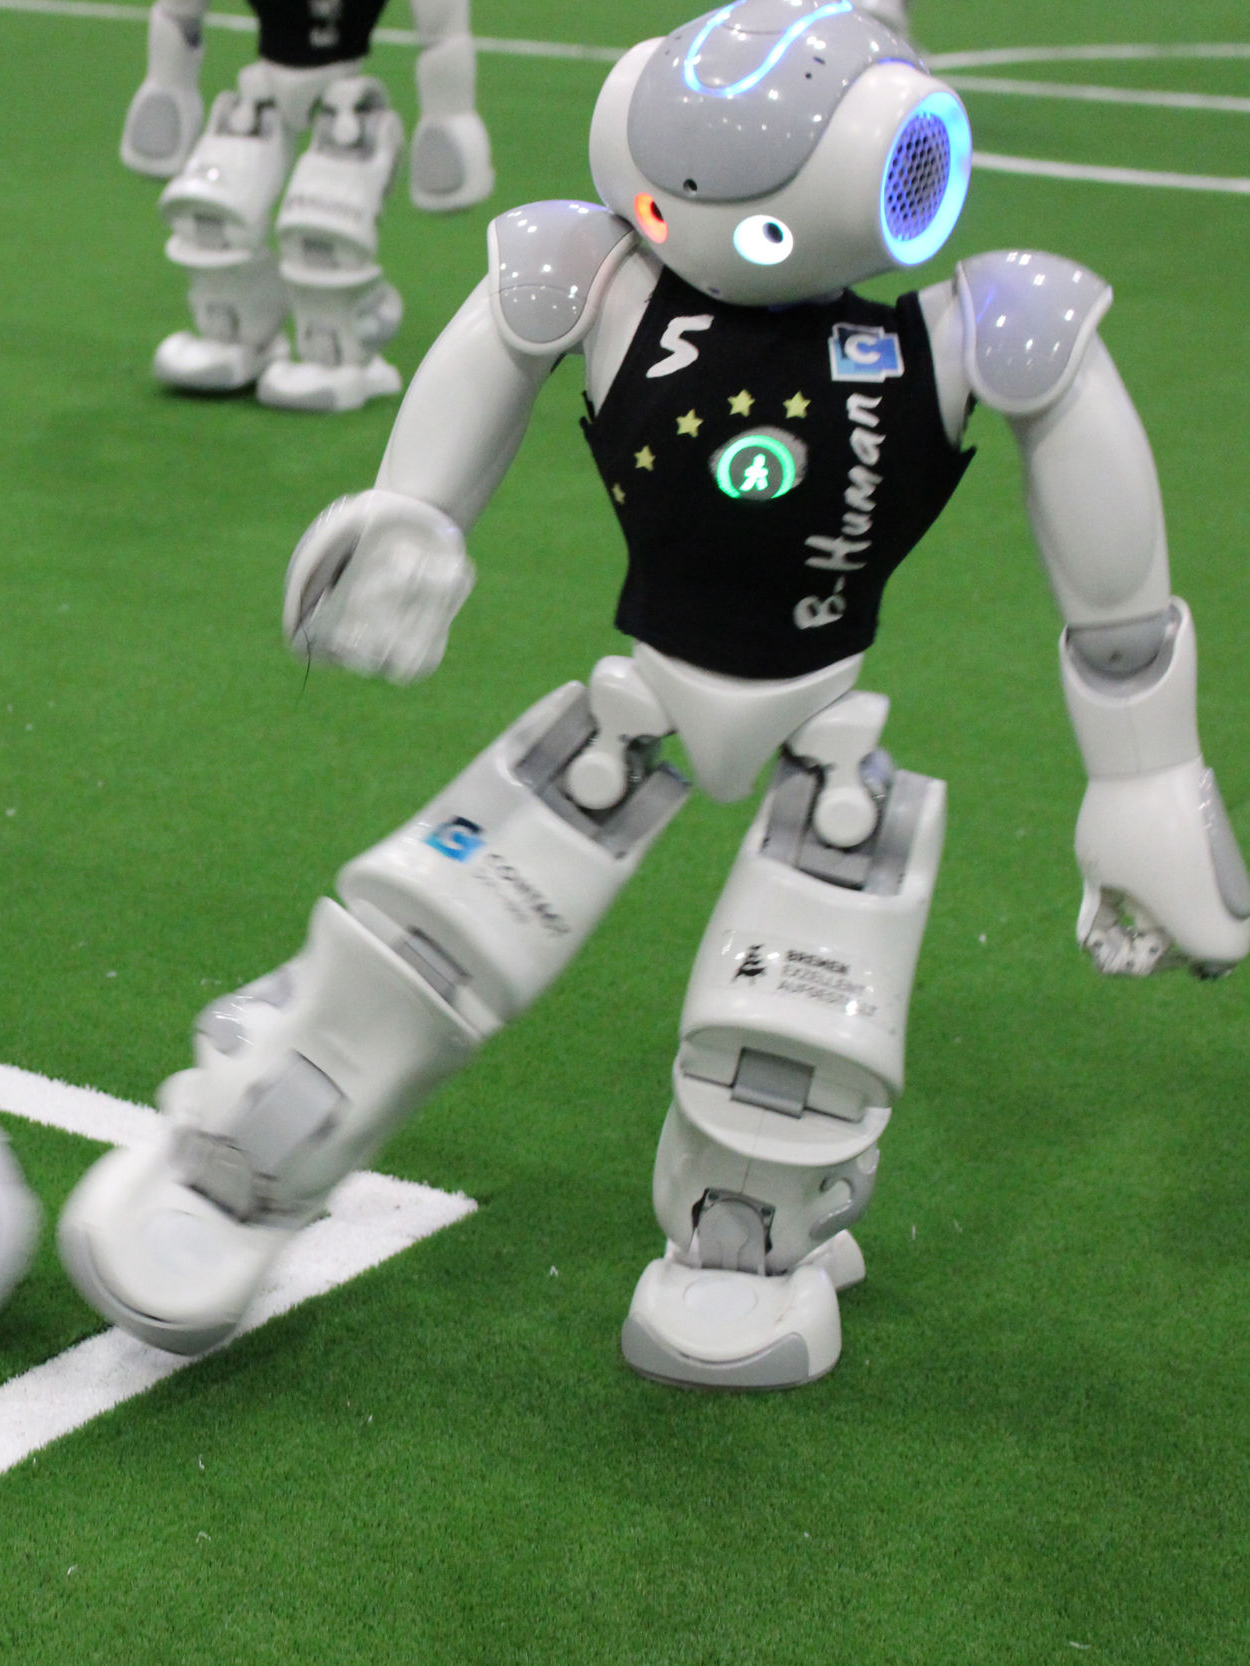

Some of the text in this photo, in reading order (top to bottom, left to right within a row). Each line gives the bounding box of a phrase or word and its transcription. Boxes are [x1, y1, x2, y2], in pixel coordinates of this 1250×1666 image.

[645, 313, 715, 379] 5
[793, 393, 887, 630] B-Human
[786, 949, 849, 975] BREMEN
